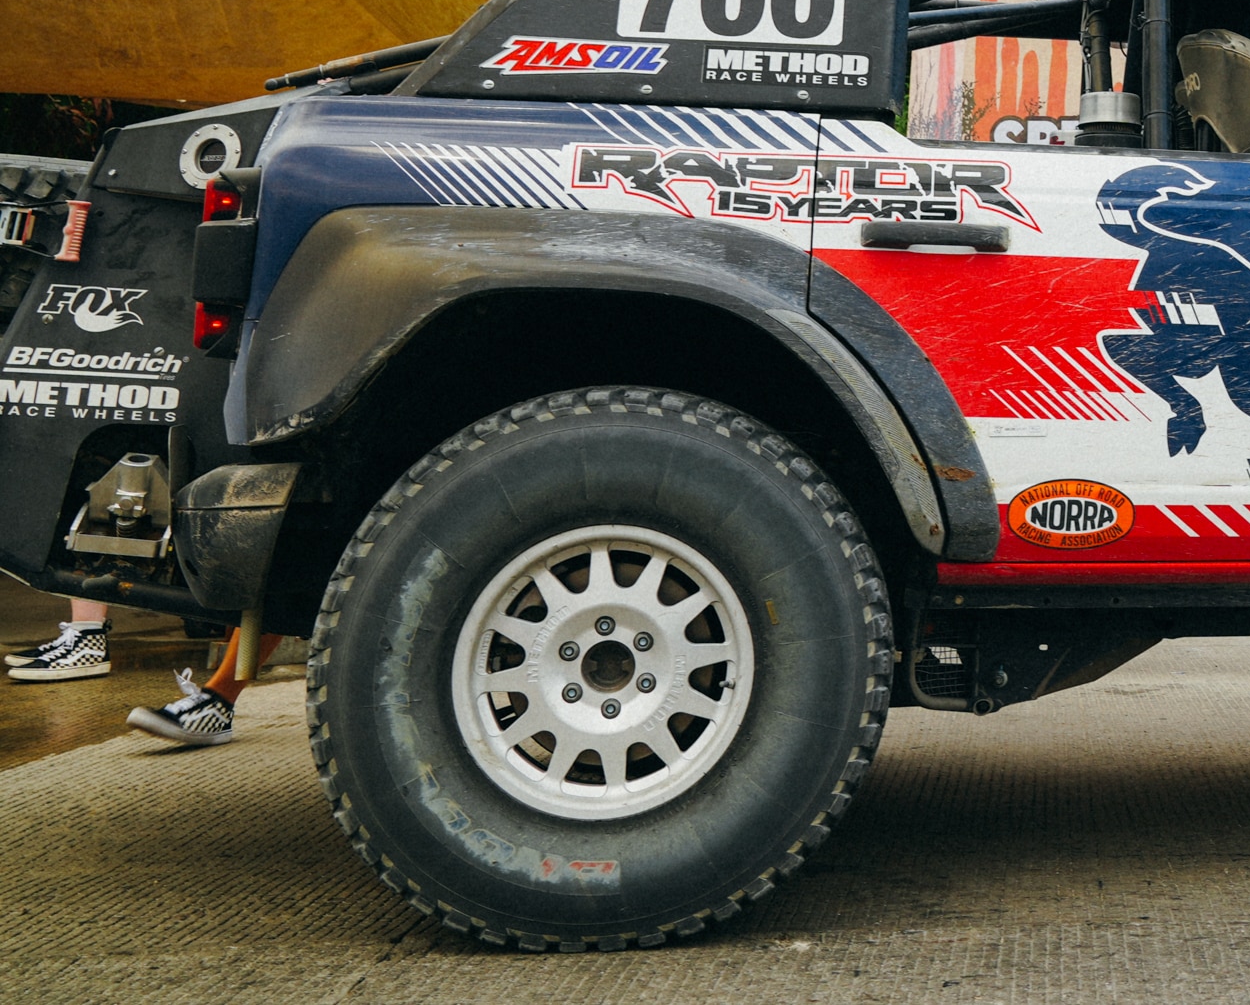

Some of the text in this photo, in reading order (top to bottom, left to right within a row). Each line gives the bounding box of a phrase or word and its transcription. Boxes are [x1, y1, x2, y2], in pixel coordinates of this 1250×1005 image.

[488, 37, 666, 75] AMSOIL
[706, 48, 870, 76] METHOD
[705, 70, 869, 87] RACE WHEELS
[578, 147, 1027, 220] RAPTOR
[716, 189, 960, 223] 15 YEARS
[37, 283, 149, 325] FOX
[6, 346, 183, 373] BFGoodrich
[0, 379, 180, 410] METHOD
[0, 405, 177, 422] ACE WHEELS
[1018, 482, 1125, 509] NATIONAL OFF ROAD
[1030, 498, 1115, 532] NORRA
[1016, 522, 1124, 547] RACING ASSOCIATION
